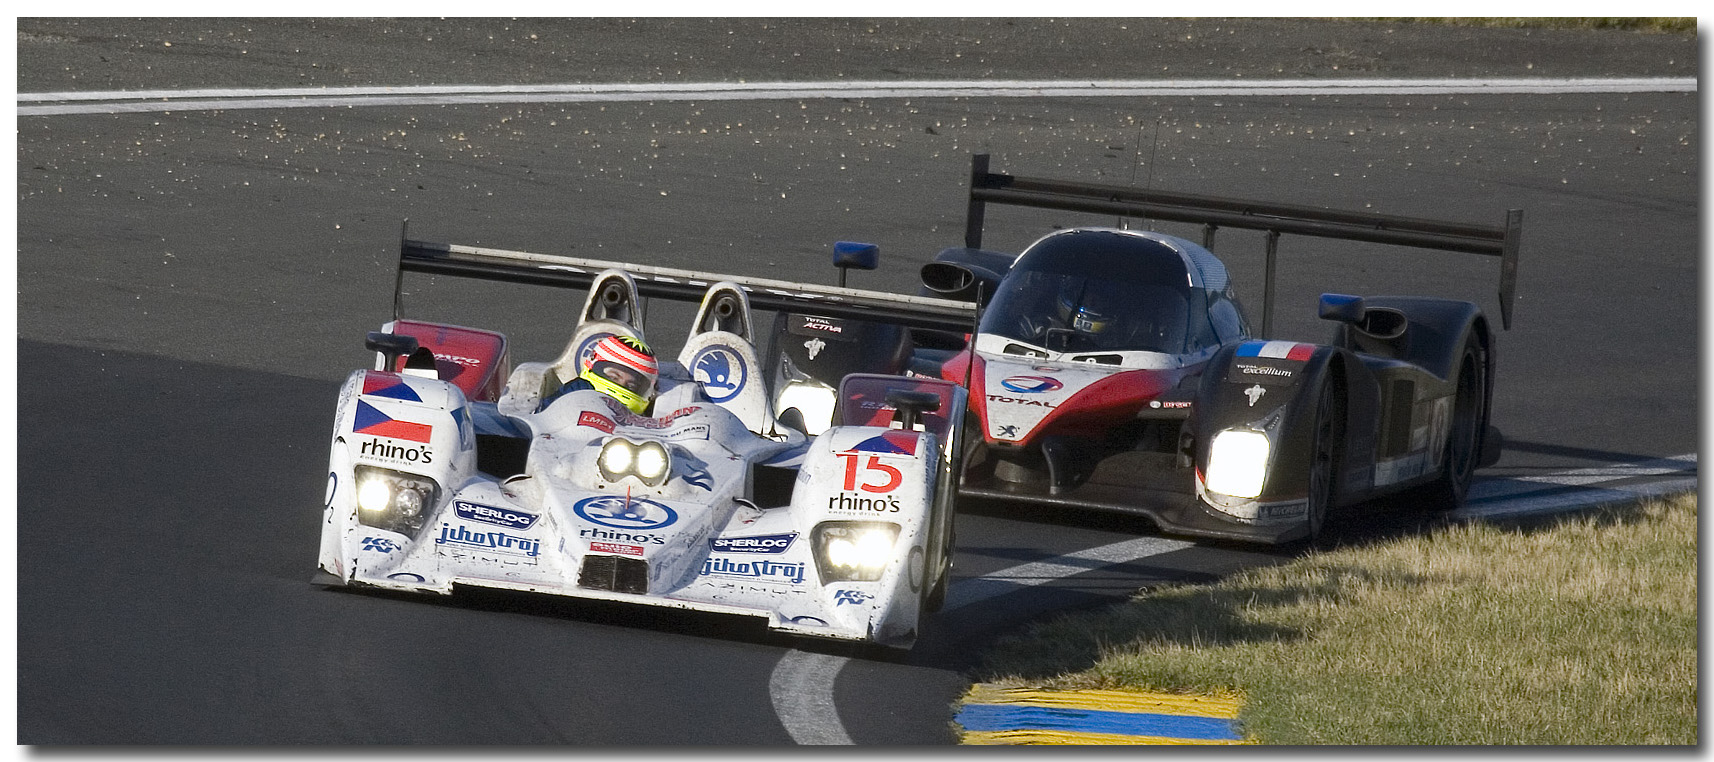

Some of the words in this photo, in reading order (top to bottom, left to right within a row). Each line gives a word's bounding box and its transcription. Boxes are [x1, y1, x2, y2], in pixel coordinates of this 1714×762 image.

[803, 323, 842, 333] ACTIVA
[1243, 367, 1293, 377] excellium
[986, 394, 1058, 408] TOTAL
[361, 438, 433, 464] rhino's
[836, 450, 903, 494] 15
[829, 492, 901, 513] rhino's
[458, 502, 530, 525] SHERLOG
[579, 528, 665, 545] rhino's
[714, 539, 788, 547] SHERLOG
